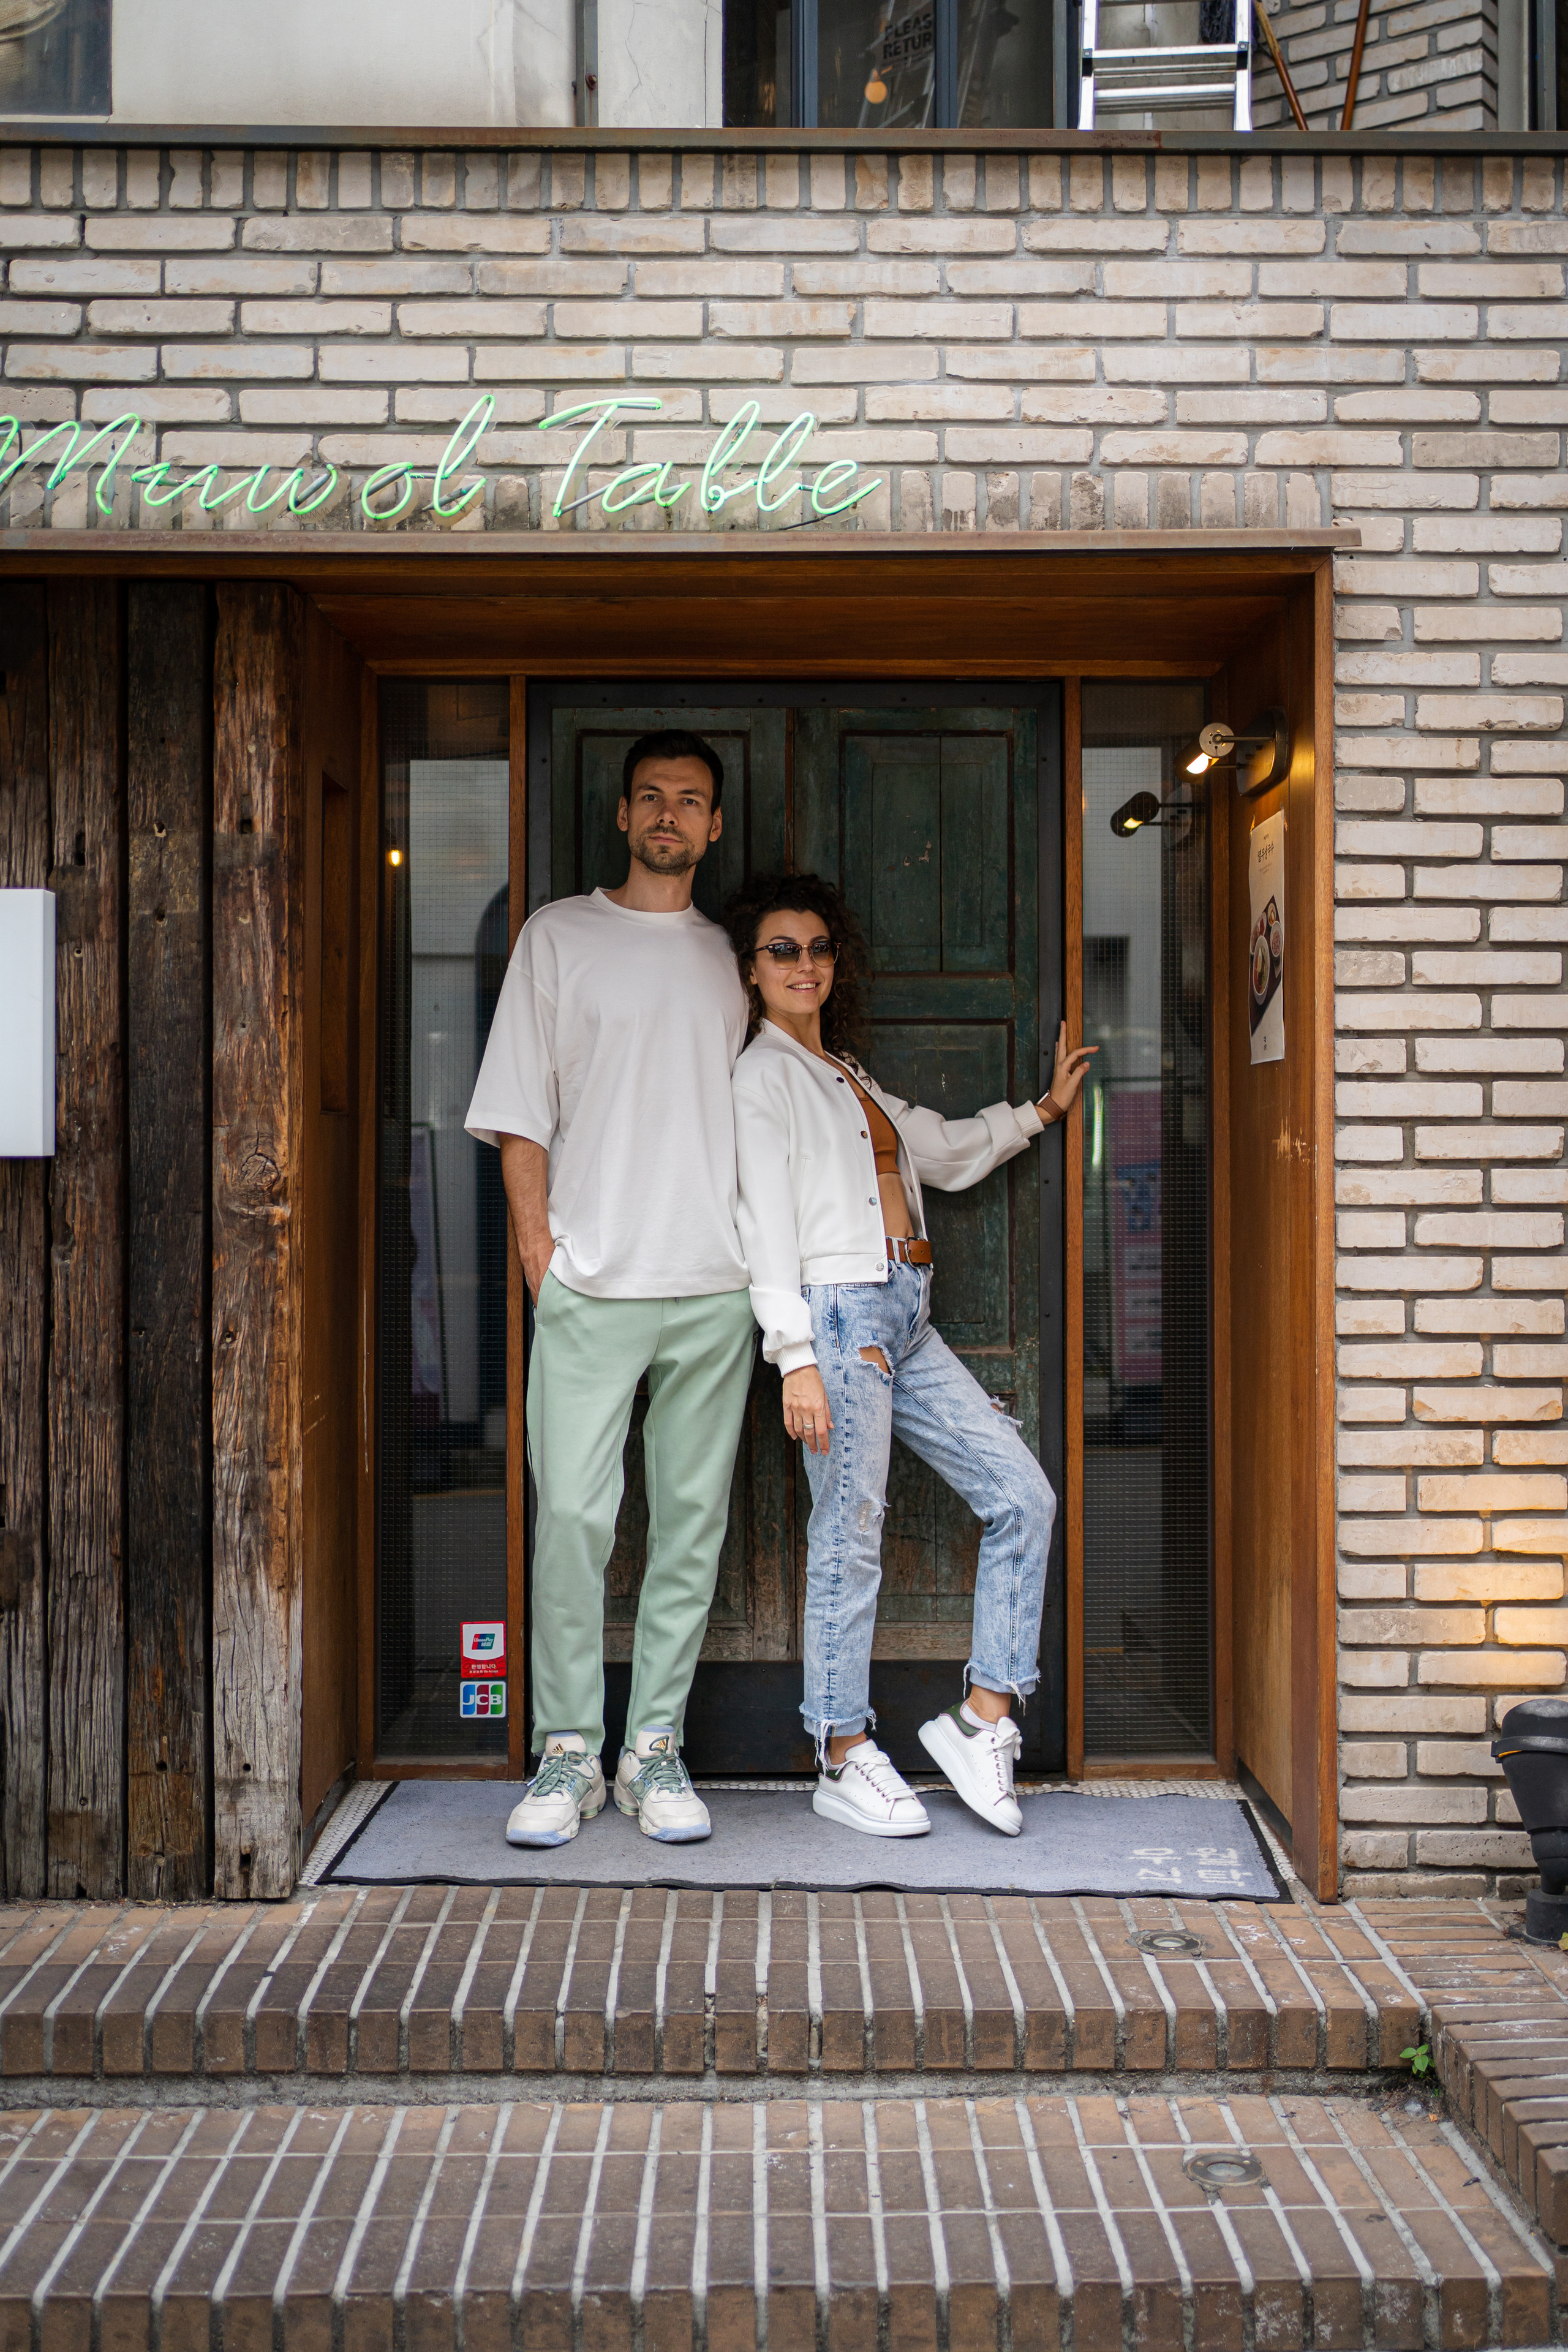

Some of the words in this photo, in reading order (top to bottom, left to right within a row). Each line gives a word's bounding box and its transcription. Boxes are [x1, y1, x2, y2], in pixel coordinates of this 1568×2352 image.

[884, 13, 932, 41] PLEAS
[883, 32, 932, 59] RETUR
[0, 394, 495, 519] Muwol
[539, 398, 882, 517] Table
[462, 1694, 502, 1705] JCB
